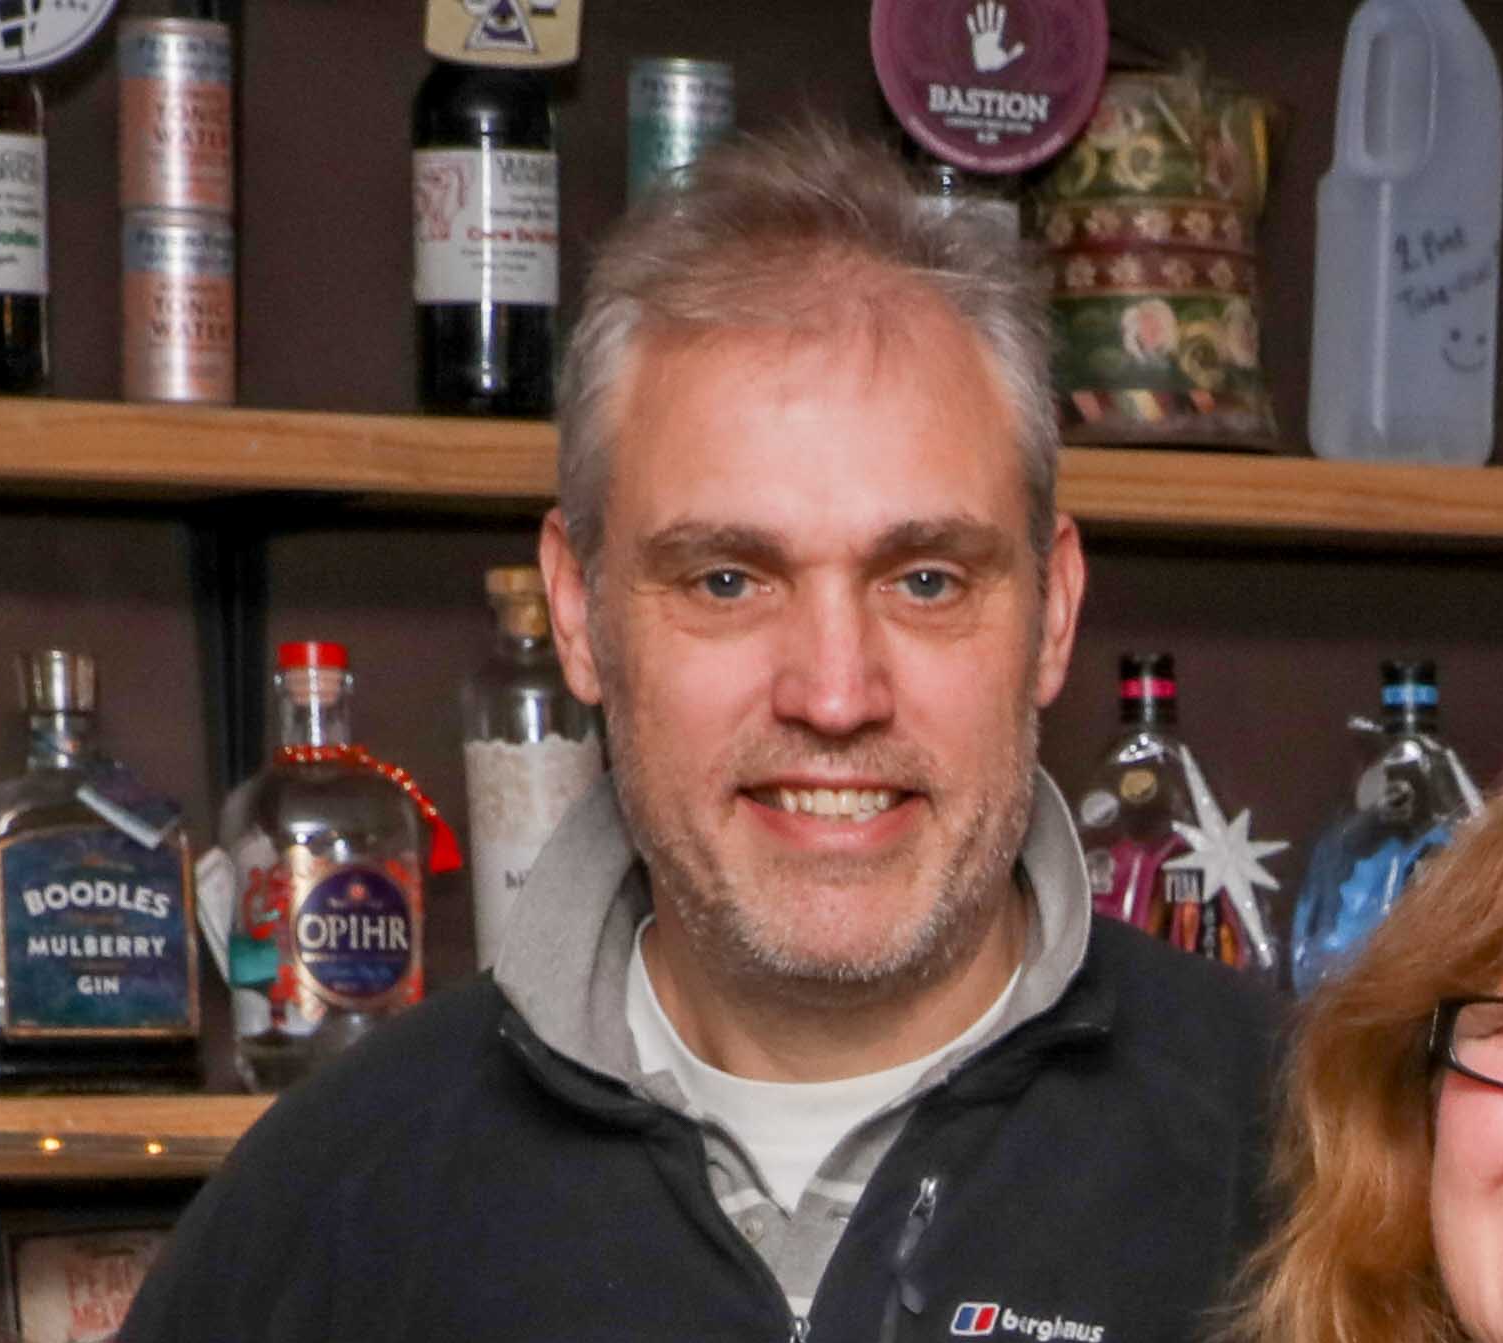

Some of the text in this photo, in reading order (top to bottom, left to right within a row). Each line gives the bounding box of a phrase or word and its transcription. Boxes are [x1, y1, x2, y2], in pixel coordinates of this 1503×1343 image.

[928, 82, 1049, 124] BASTION
[22, 880, 172, 920] BOODLES
[27, 934, 166, 960] MULBERRY
[298, 911, 409, 955] OPIHR
[77, 974, 120, 997] GIN
